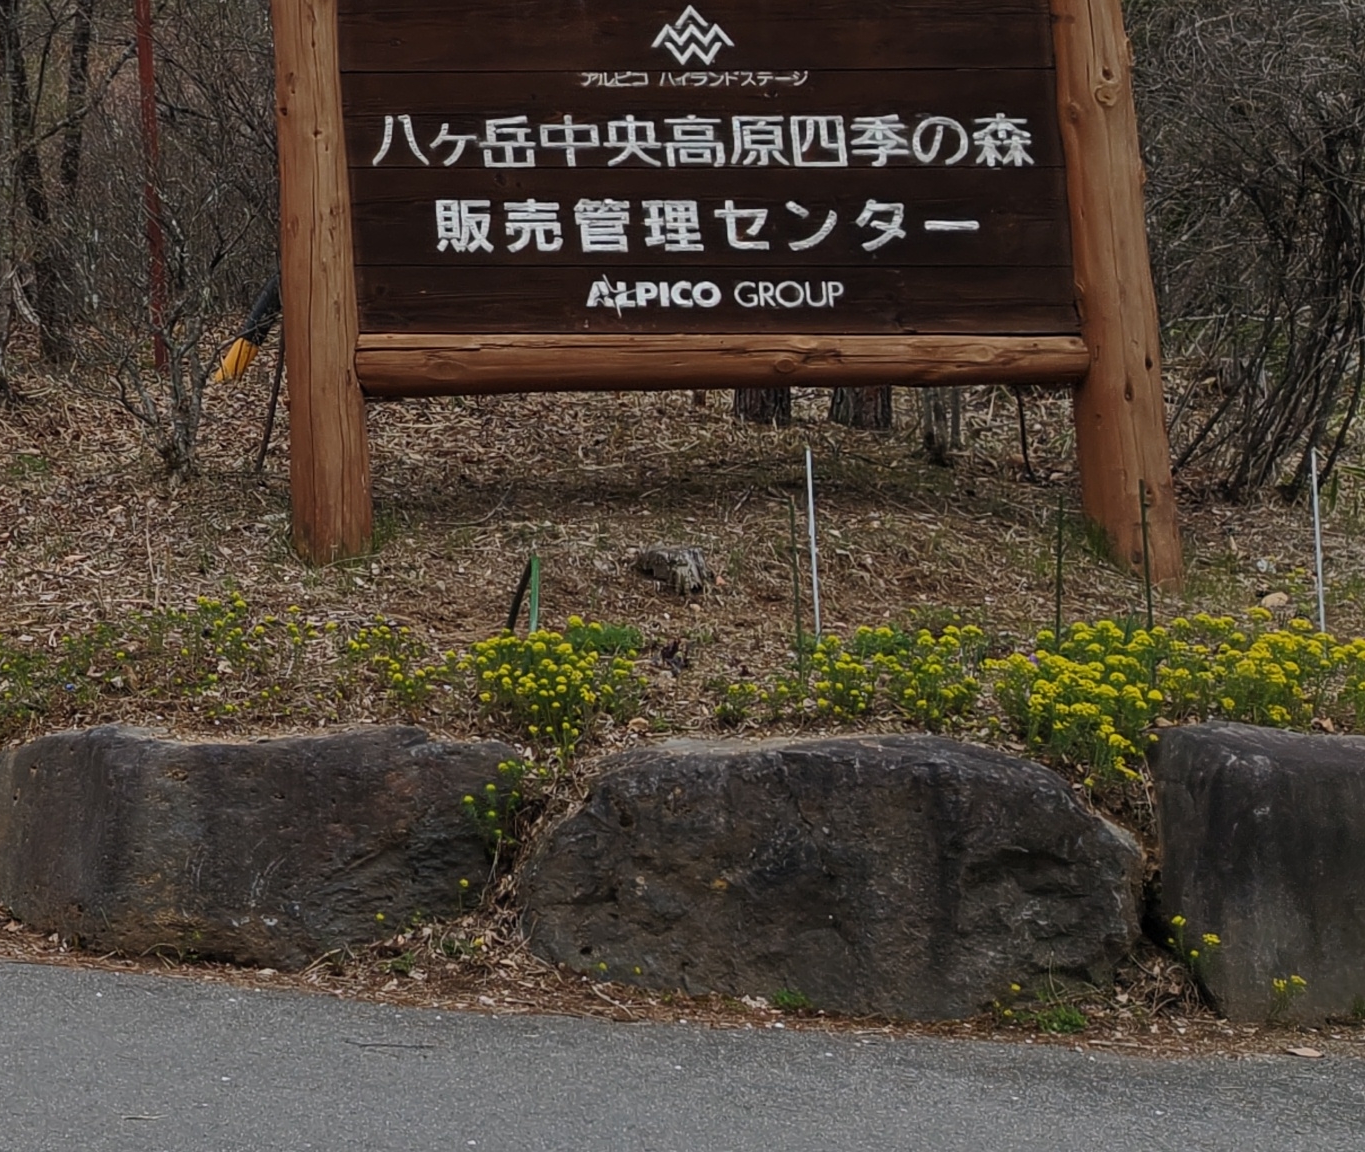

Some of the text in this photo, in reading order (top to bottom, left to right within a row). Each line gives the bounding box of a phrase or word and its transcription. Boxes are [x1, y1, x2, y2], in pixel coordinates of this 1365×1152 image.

[581, 70, 809, 87] アルピコ ハイランドステージ
[372, 112, 1035, 168] 八ヶ岳中央高原四季の森
[435, 198, 980, 253] 販売管理センター
[585, 277, 844, 313] ALPICO GROUP
